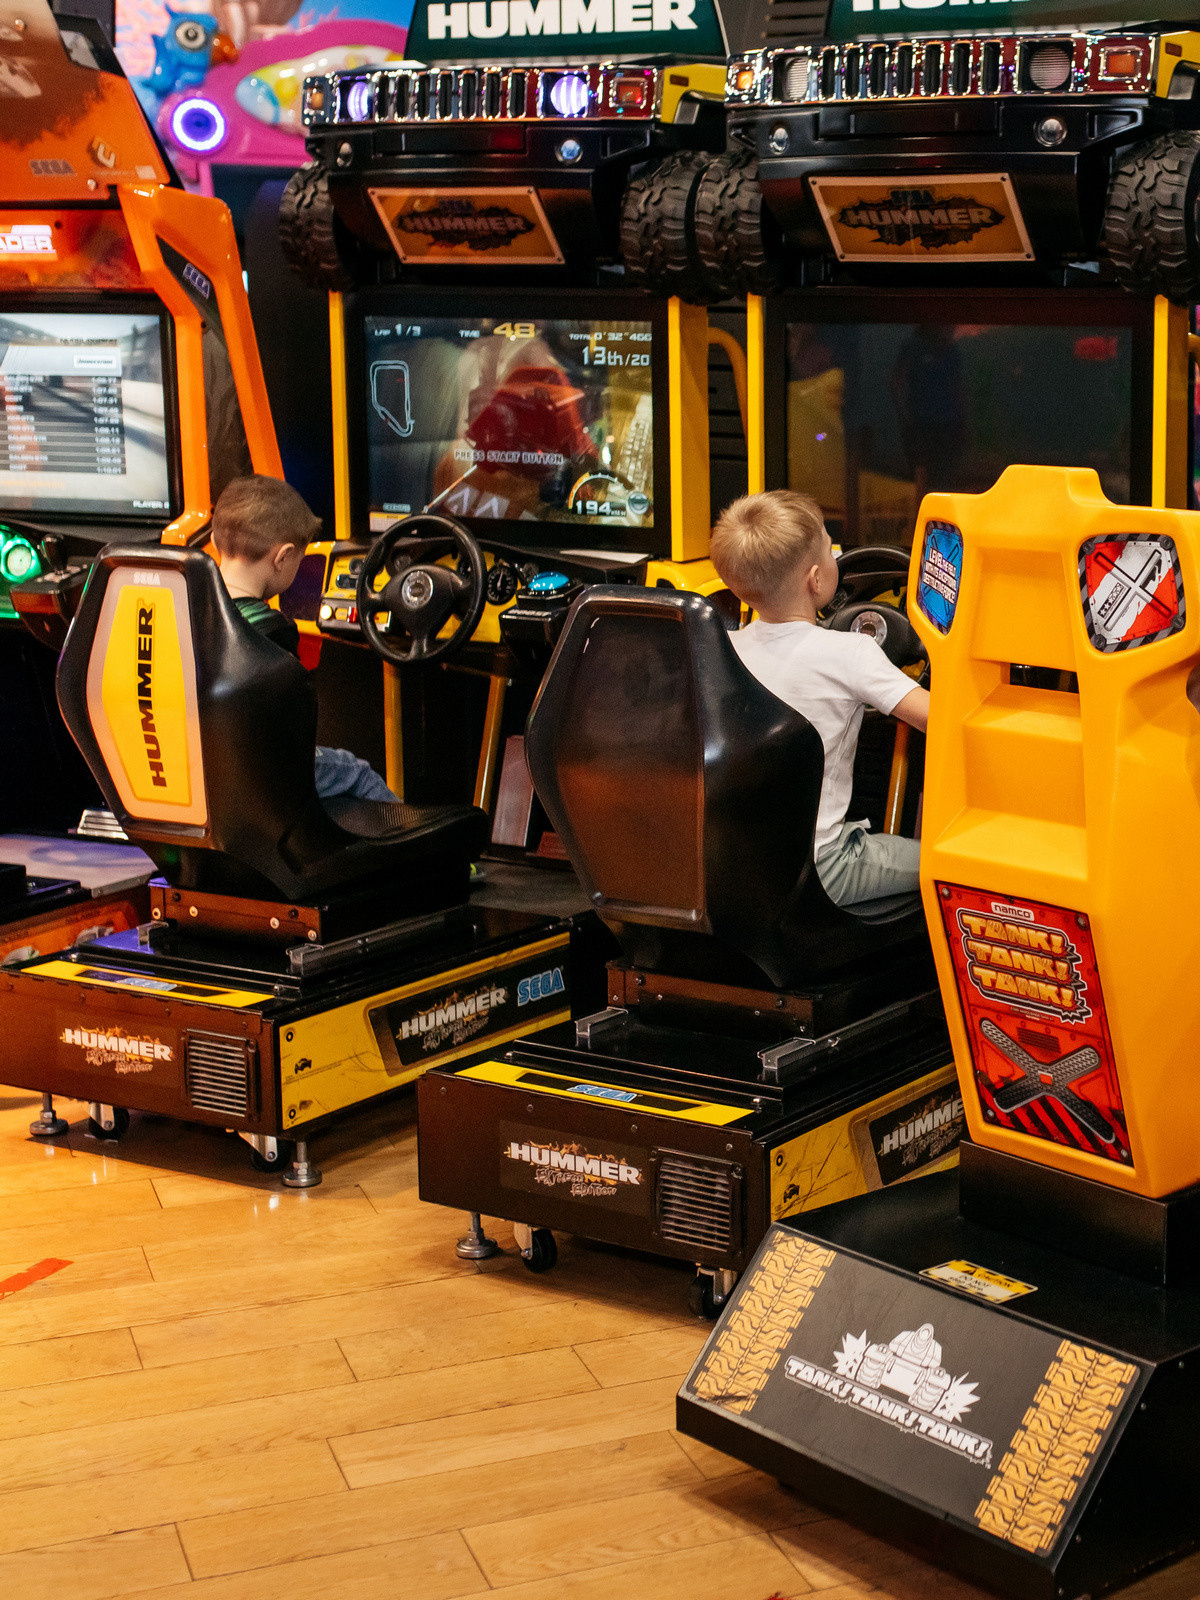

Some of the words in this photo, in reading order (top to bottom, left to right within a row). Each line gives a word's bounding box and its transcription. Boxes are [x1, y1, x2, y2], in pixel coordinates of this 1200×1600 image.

[428, 0, 698, 39] HUMMER
[399, 216, 525, 232] HUMMER
[846, 207, 993, 225] HUMMER
[493, 322, 536, 338] 48
[454, 450, 485, 462] PRESS
[487, 451, 521, 464] START
[522, 452, 564, 465] BUTTON
[575, 500, 610, 515] 194
[133, 572, 161, 586] SEGA
[137, 607, 168, 788] HUMMER
[994, 903, 1032, 919] namco
[961, 914, 1064, 955] TANK!
[966, 939, 1069, 981] TANK!
[517, 966, 566, 1007] SEGA
[972, 965, 1075, 1008] TANK!
[402, 988, 506, 1040] HUMMER
[64, 1028, 172, 1061] HUMMER
[566, 1084, 637, 1102] SEGA
[883, 1098, 965, 1155] HUMME
[510, 1142, 641, 1185] HUMMER
[787, 1358, 852, 1397] TANK!
[850, 1387, 917, 1427] TANK!
[915, 1415, 991, 1458] TANK!
